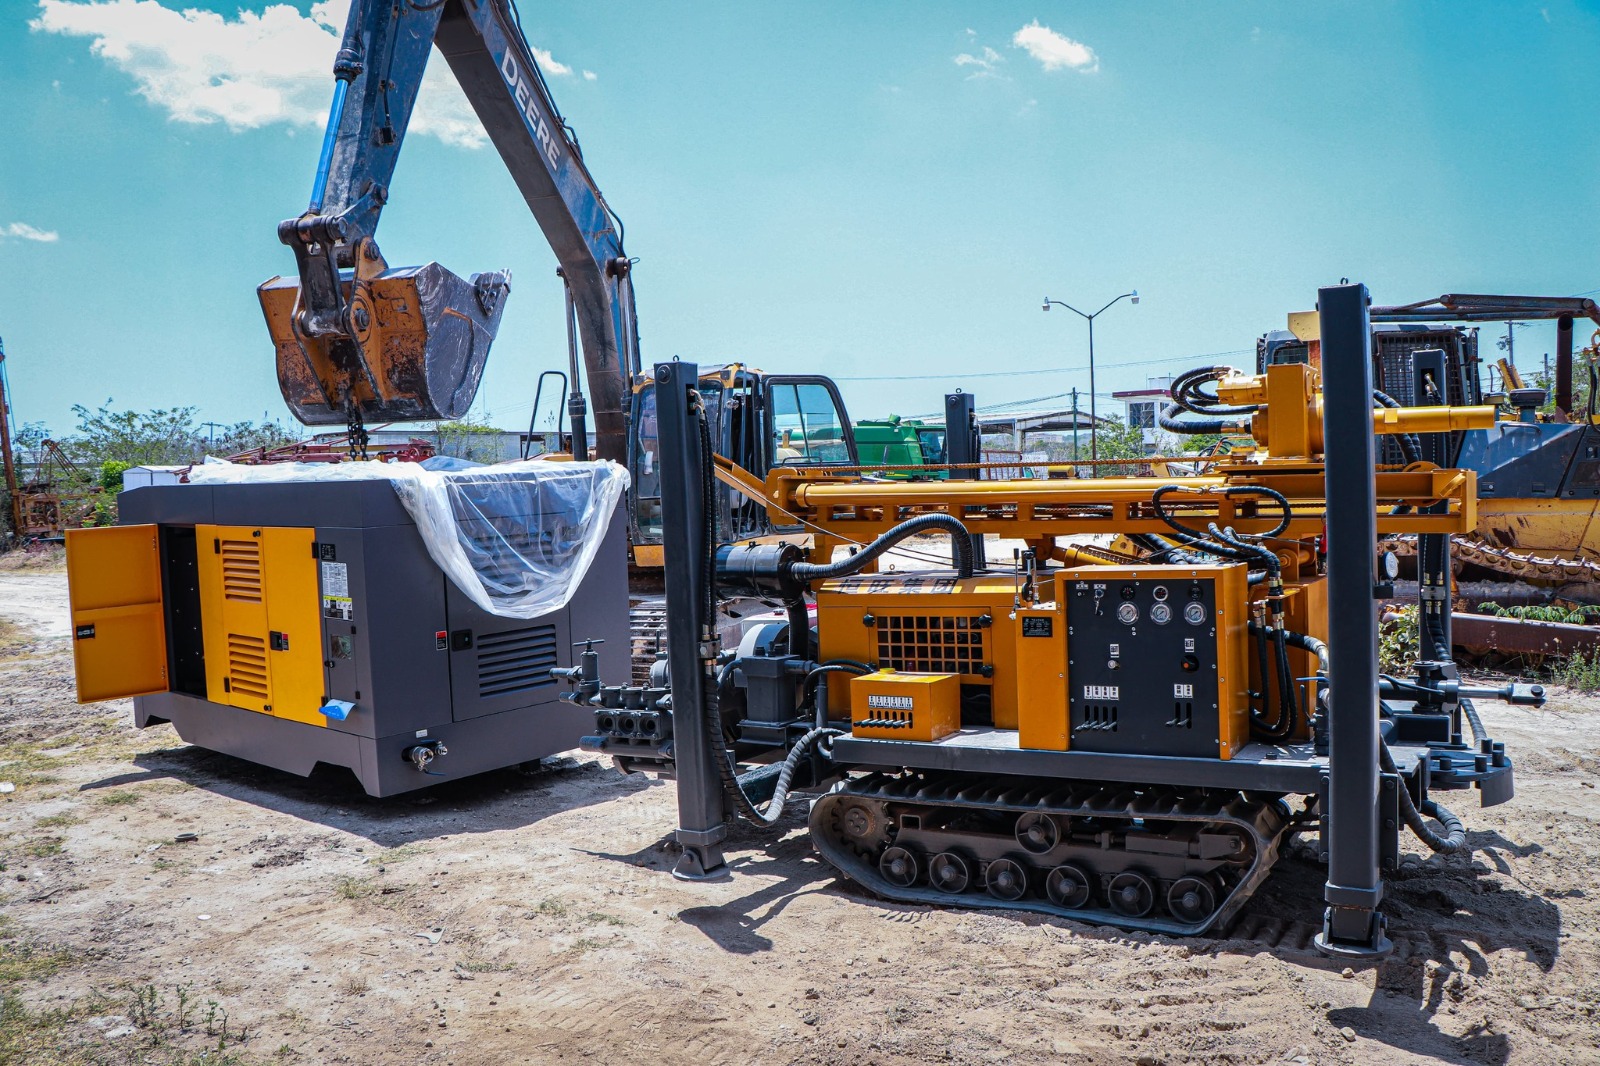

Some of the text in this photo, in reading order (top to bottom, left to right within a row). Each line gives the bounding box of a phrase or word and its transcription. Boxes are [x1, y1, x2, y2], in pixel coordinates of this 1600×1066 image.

[501, 46, 561, 171] DEERE
[838, 578, 958, 594] 恒旺集团
